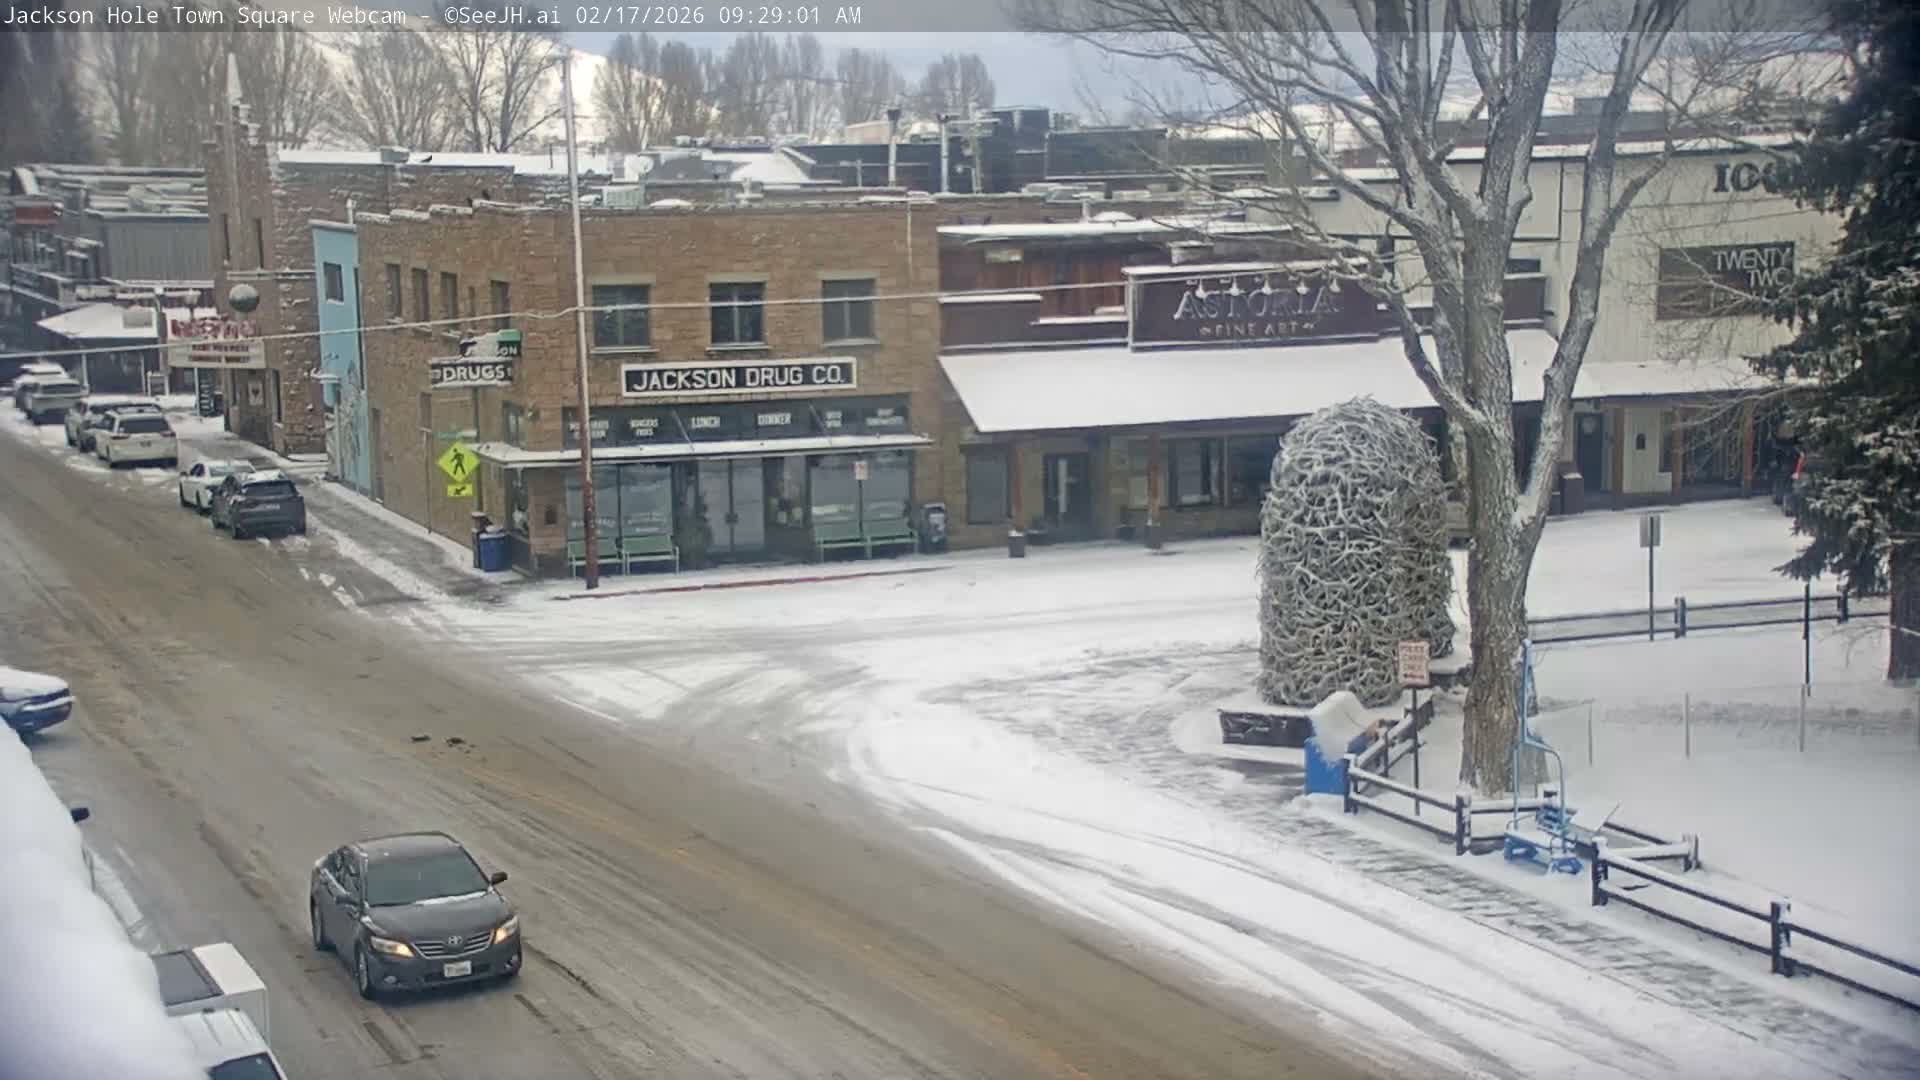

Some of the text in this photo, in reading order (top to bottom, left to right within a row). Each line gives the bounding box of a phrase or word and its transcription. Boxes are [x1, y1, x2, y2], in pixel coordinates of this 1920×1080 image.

[1712, 247, 1791, 271] TWENTY
[1173, 286, 1345, 319] ASTORIA
[1215, 321, 1299, 336] FINE ART
[442, 364, 505, 382] DRUGS
[633, 365, 846, 391] JACKSON DRUG CO.
